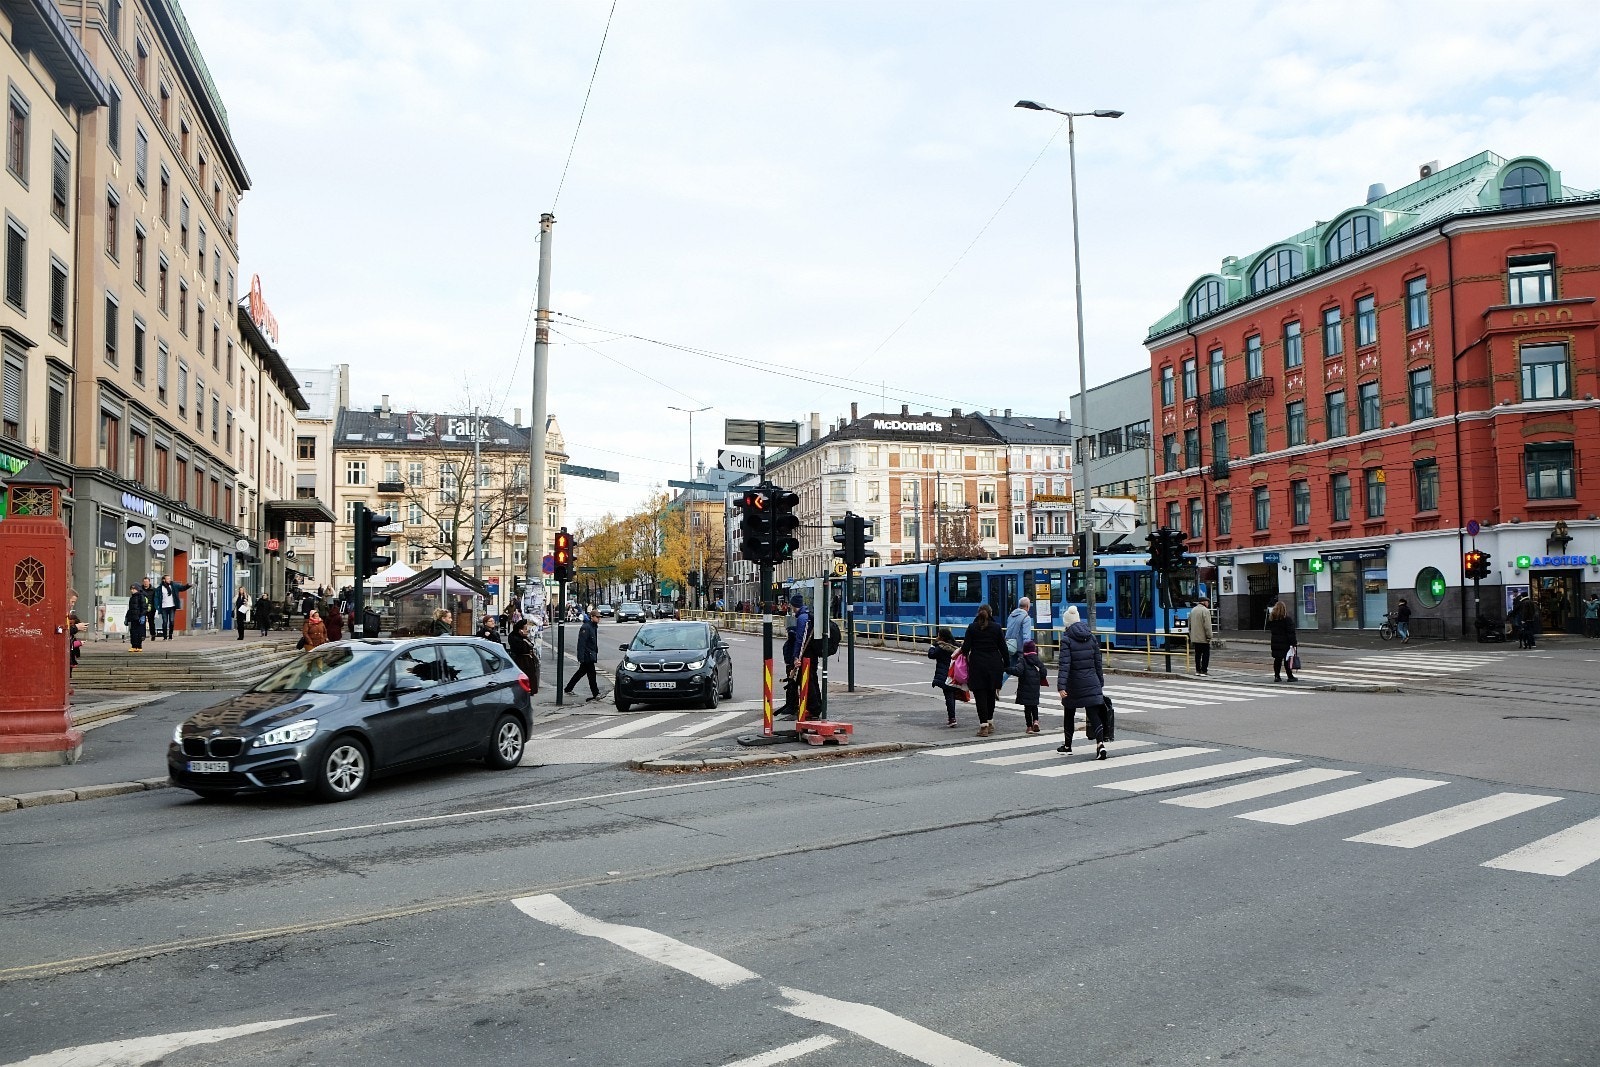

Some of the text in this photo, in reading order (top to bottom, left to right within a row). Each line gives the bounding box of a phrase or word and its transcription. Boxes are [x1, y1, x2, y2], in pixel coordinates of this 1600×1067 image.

[873, 419, 943, 432] McDonald's
[730, 454, 755, 470] Politi
[1532, 554, 1598, 567] APOTEK 1
[1224, 581, 1232, 591] 51
